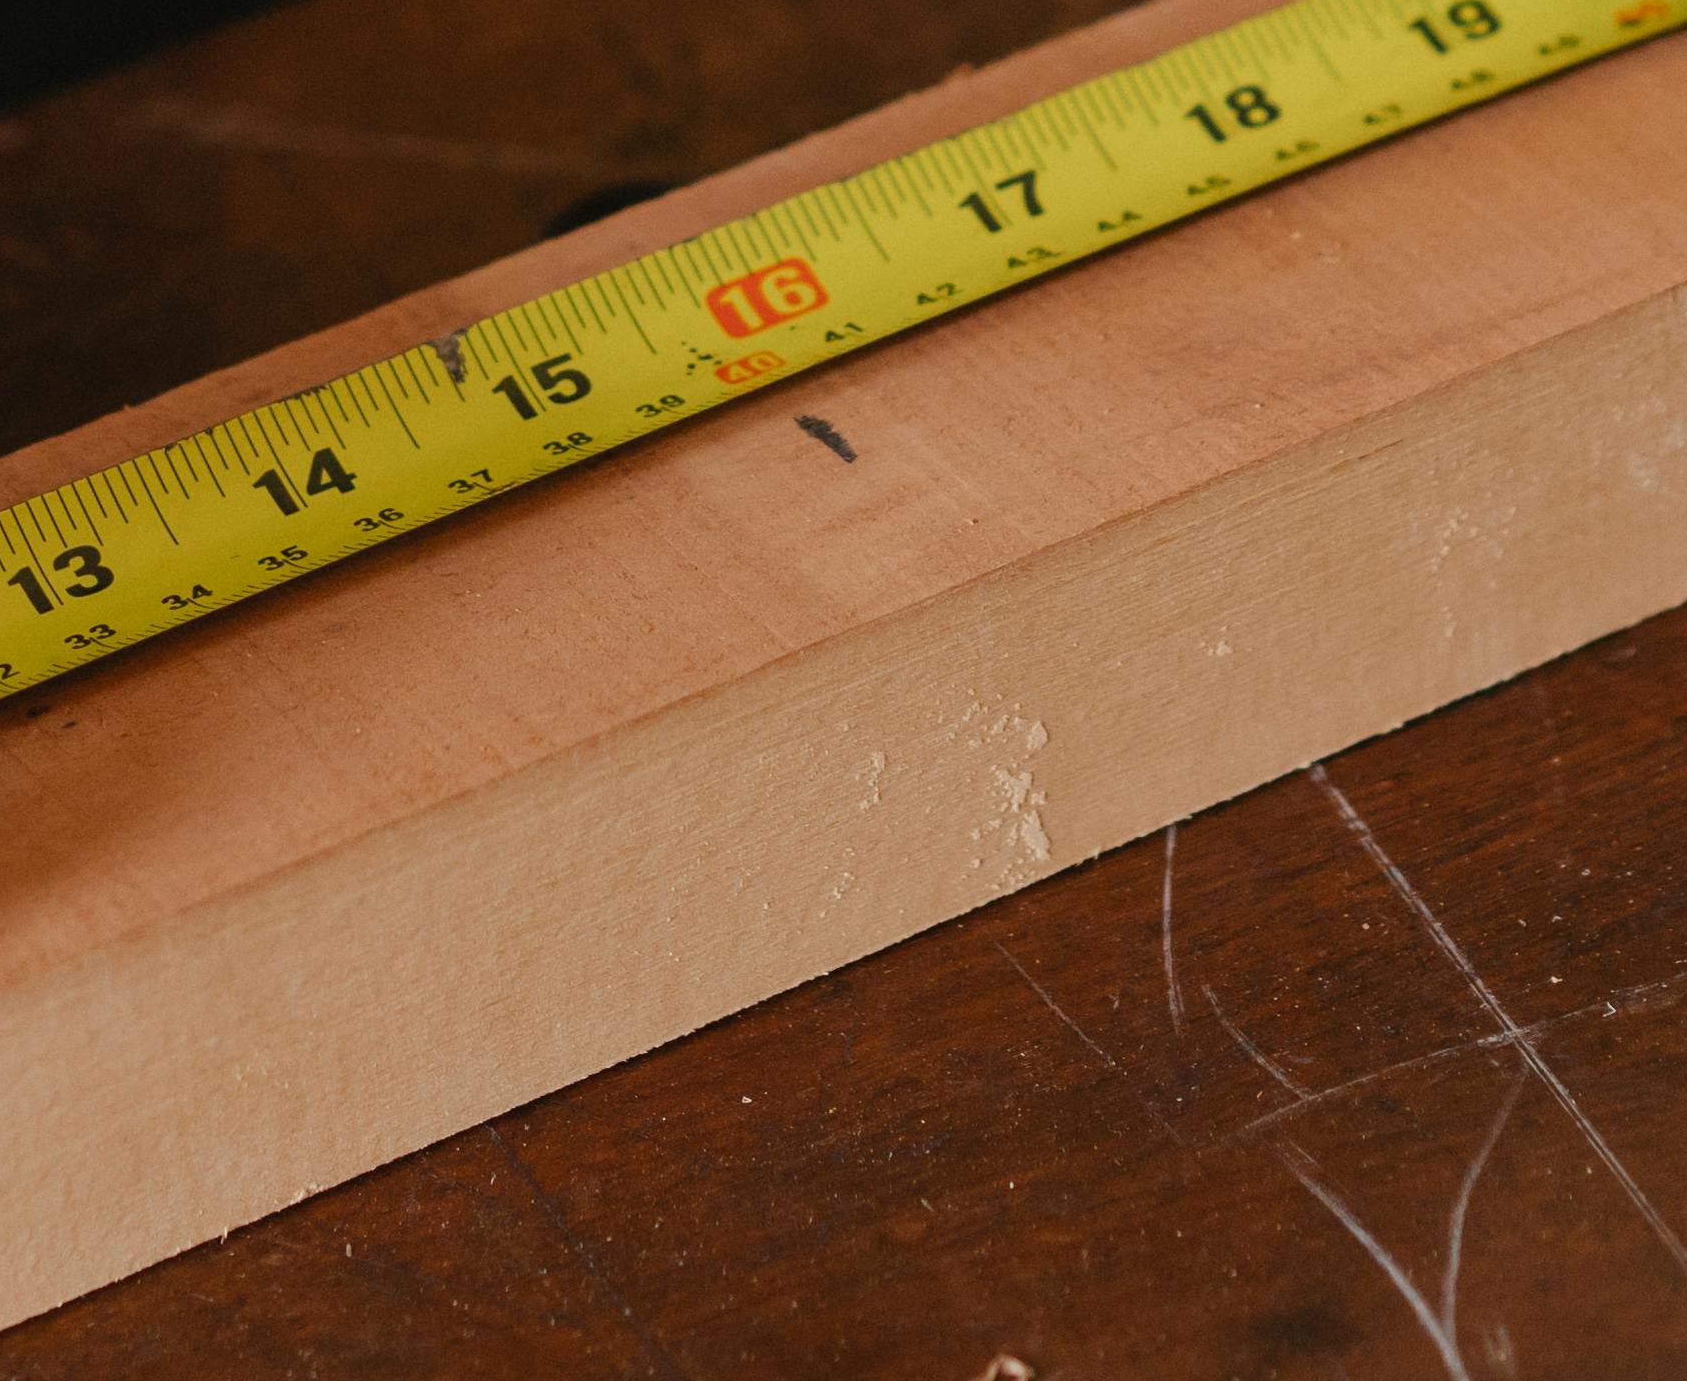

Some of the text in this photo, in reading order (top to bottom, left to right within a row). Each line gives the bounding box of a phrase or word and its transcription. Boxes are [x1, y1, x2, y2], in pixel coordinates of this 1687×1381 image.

[1186, 85, 1282, 143] 18
[959, 170, 1045, 233] 17
[720, 268, 817, 330] 16
[916, 283, 956, 306] 42
[825, 321, 864, 343] 41
[730, 354, 779, 380] 40
[491, 354, 592, 420] 15
[635, 395, 685, 419] 39
[543, 432, 593, 456] 38
[252, 447, 356, 516] 14
[448, 469, 492, 495] 37
[354, 508, 405, 533] 36
[257, 545, 309, 572] 35
[8, 545, 114, 615] 13
[161, 584, 213, 611] 34
[64, 624, 117, 651] 33
